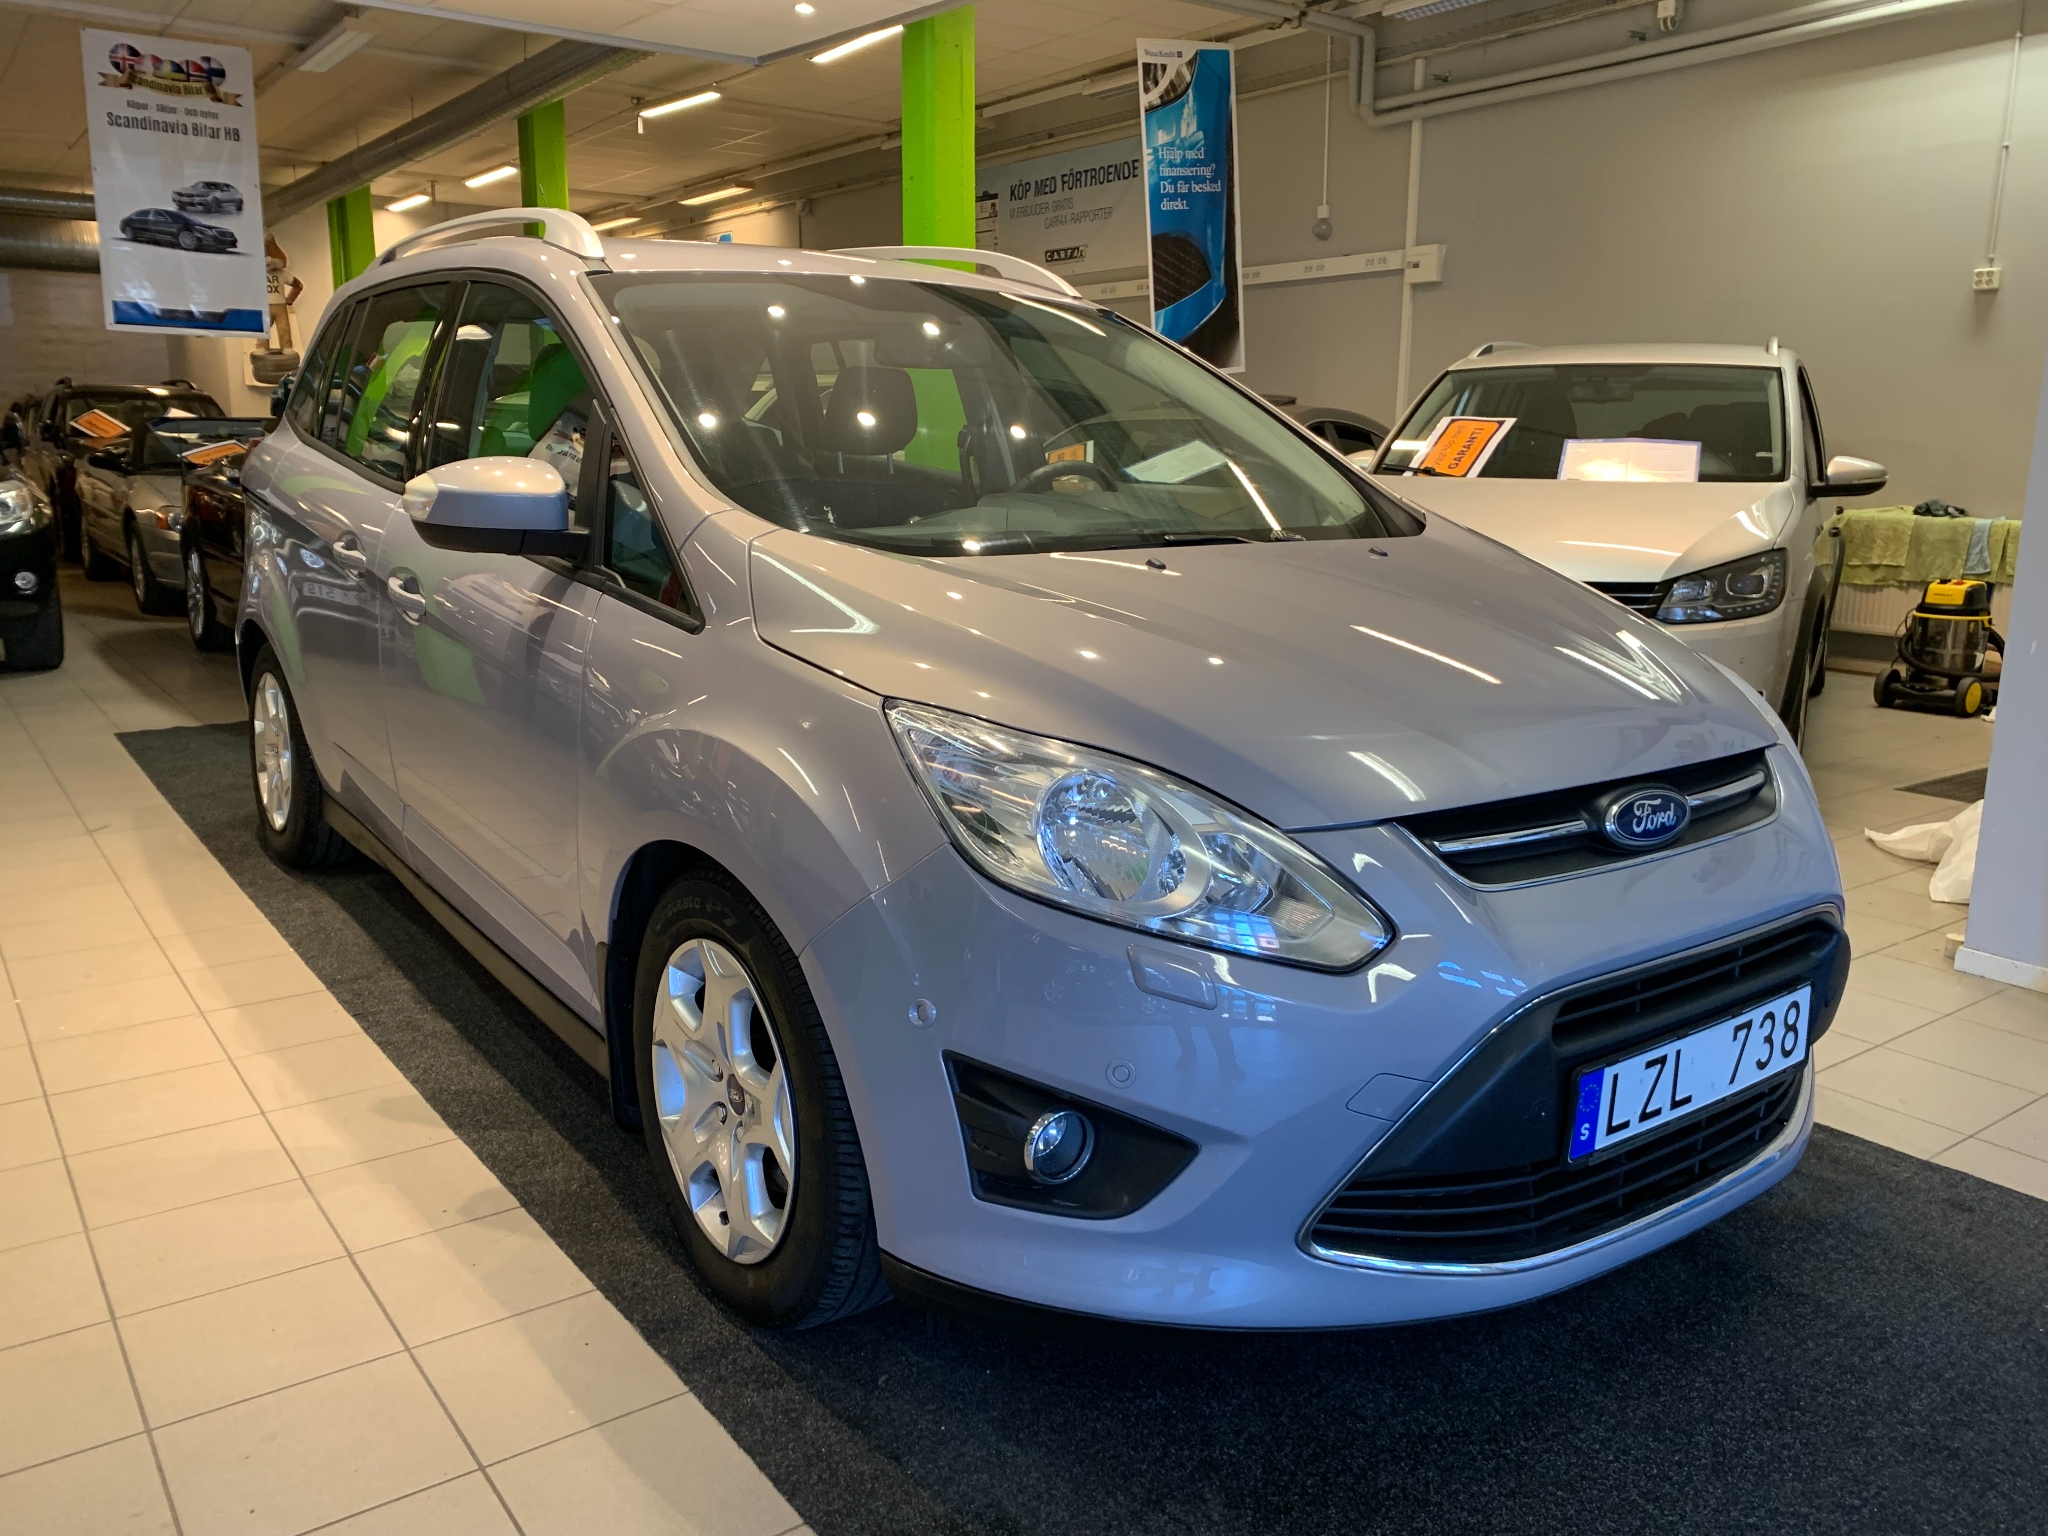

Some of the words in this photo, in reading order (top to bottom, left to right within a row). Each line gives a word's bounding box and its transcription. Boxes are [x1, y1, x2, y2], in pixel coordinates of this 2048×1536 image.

[106, 111, 189, 136] Scandinavia
[192, 122, 221, 139] Bilar
[224, 126, 240, 142] HB
[1158, 146, 1183, 163] Hjälp
[1185, 146, 1205, 159] med
[1009, 179, 1031, 202] KÖP
[1033, 176, 1057, 198] MED
[1061, 158, 1140, 192] FÖRTROENDE
[1159, 163, 1216, 179] finansiering?
[1160, 179, 1175, 194] Du
[1177, 180, 1190, 193] får
[1191, 179, 1222, 193] besked
[1009, 208, 1016, 219] VI
[1016, 201, 1050, 219] ERBJUDER
[1051, 197, 1074, 213] GRATIS
[1160, 197, 1190, 211] direkt.
[1044, 206, 1114, 230] CARFAX-RAPPORTER
[1045, 246, 1086, 262] CARFAX
[266, 275, 280, 284] AR
[266, 284, 280, 294] OX
[1447, 427, 1485, 470] GARANTI
[1632, 798, 1677, 834] Ford
[1605, 1048, 1693, 1137] LZL
[1728, 1000, 1801, 1086] 738
[1579, 1122, 1590, 1141] S
